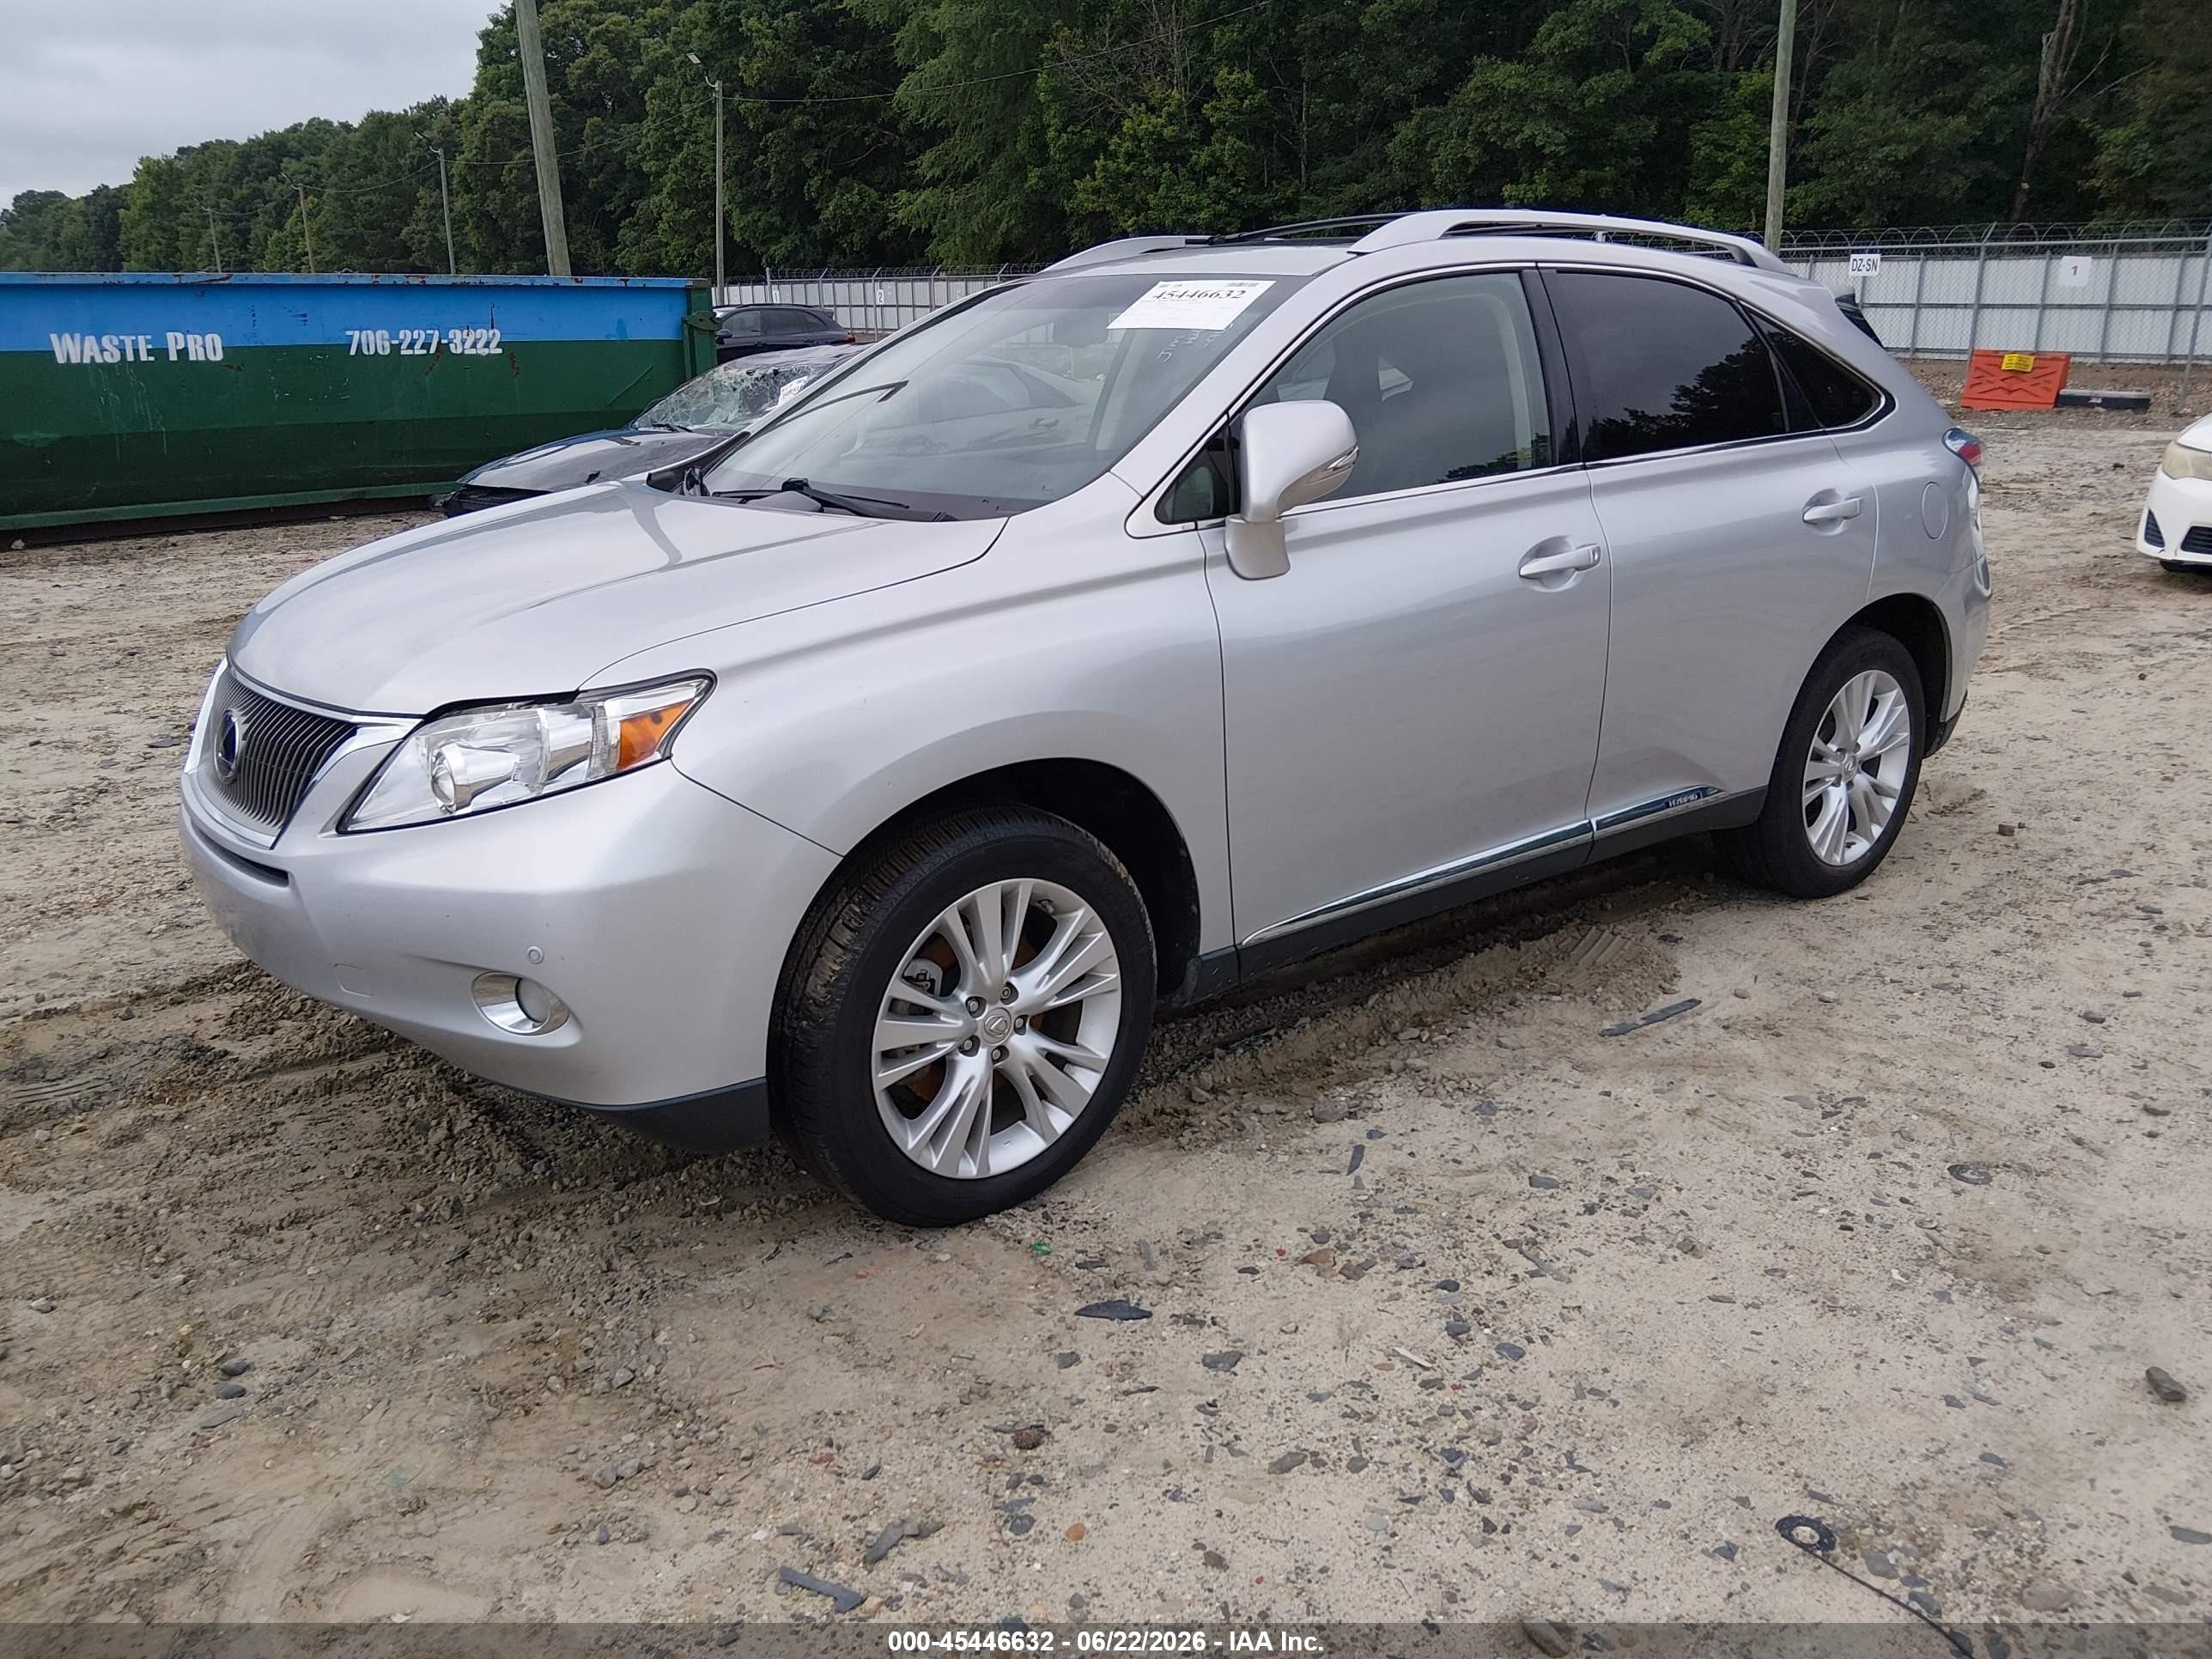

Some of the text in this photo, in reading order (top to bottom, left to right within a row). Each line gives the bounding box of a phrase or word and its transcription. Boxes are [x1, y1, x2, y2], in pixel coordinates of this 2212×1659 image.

[1851, 258, 1879, 272] DZ-SN
[2071, 265, 2078, 276] 1
[1152, 289, 1247, 300] 45446632
[49, 331, 224, 364] WASTE PRO
[345, 328, 503, 356] 706-227-3222
